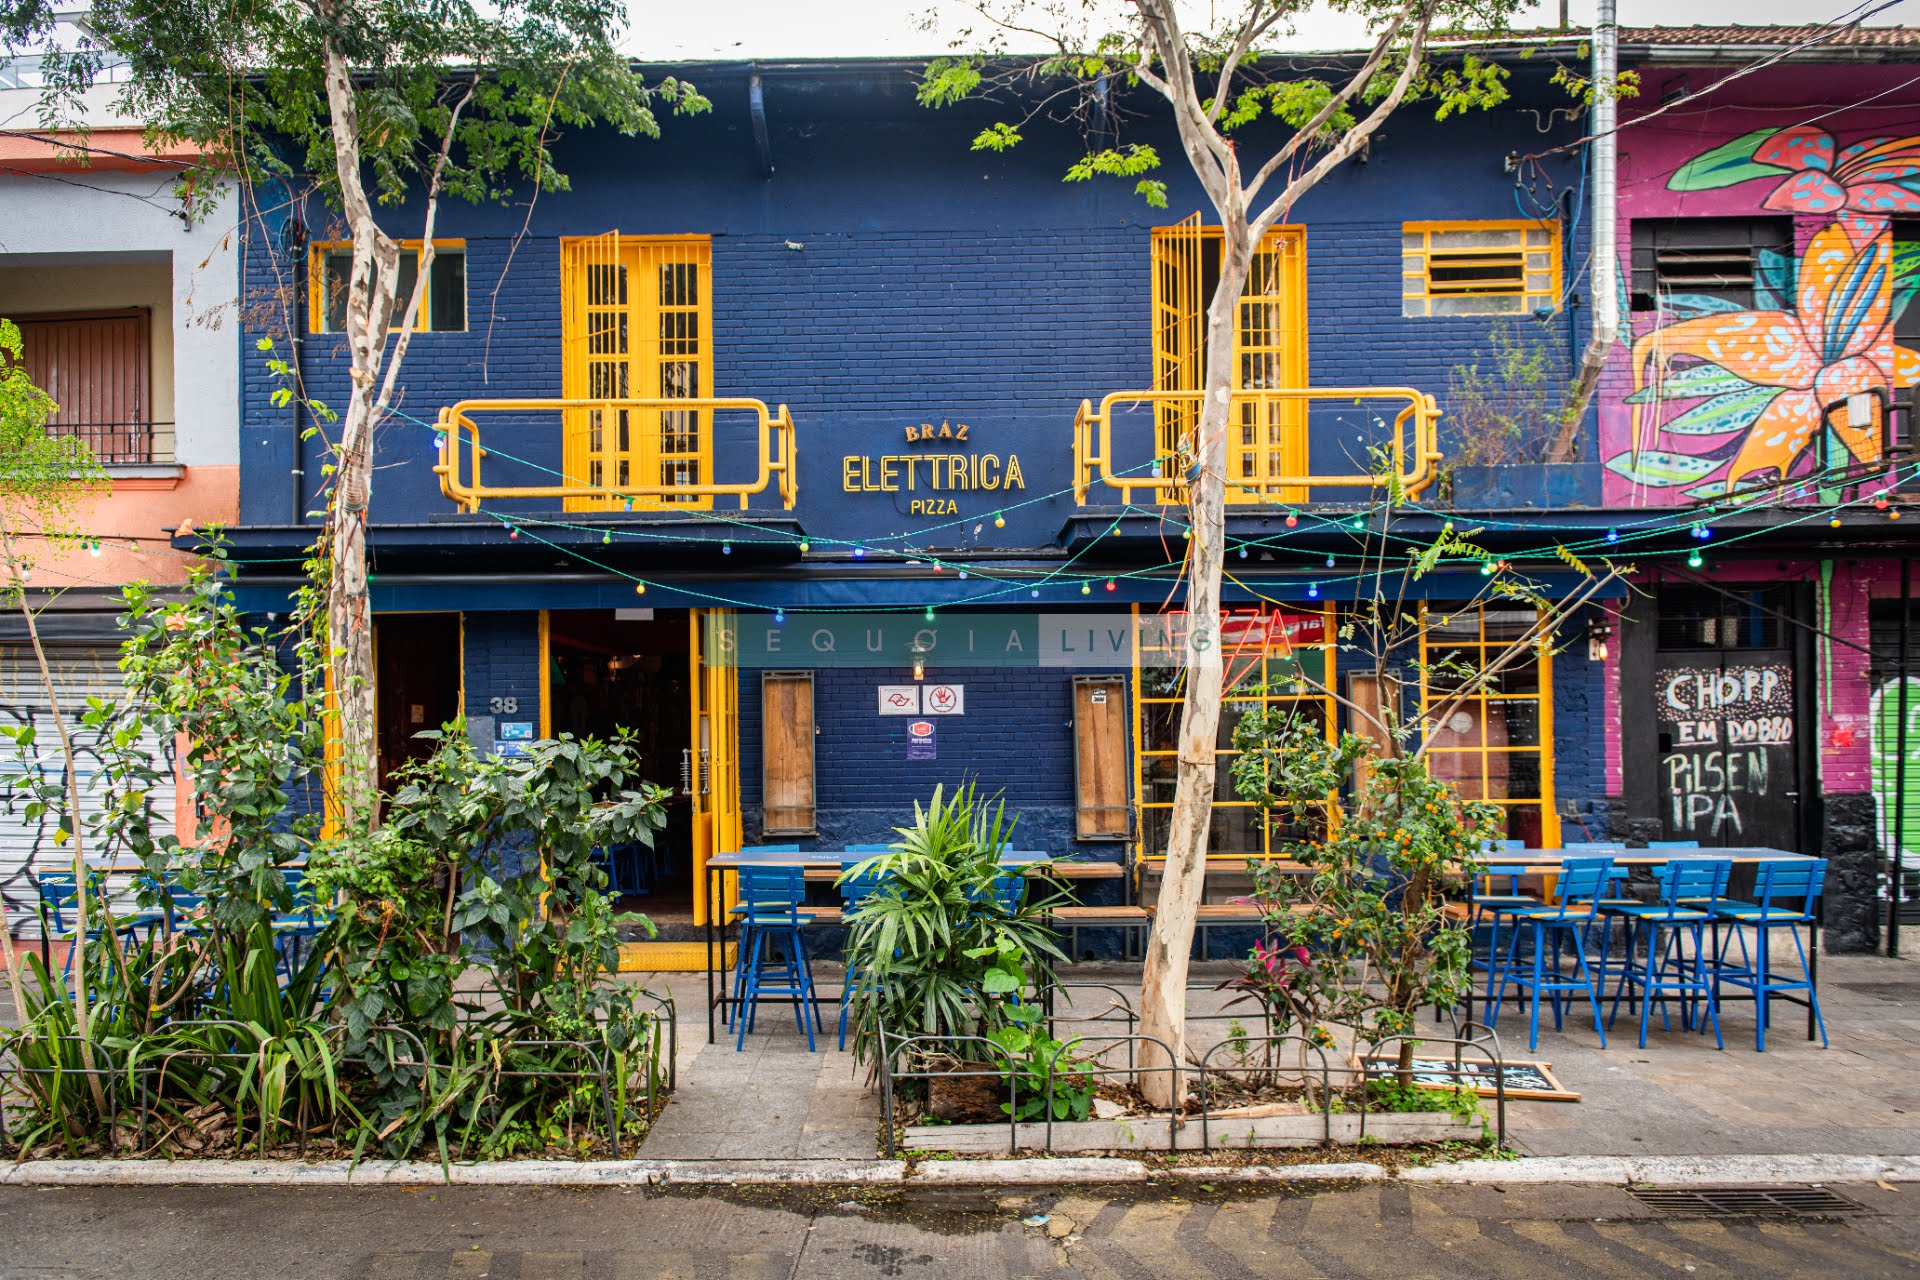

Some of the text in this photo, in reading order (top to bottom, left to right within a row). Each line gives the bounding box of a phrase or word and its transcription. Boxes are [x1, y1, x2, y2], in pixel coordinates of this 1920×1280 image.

[843, 454, 1024, 492] ELETTRICA
[910, 499, 958, 515] PIZZA
[1666, 670, 1779, 711] CHOPP
[489, 696, 518, 714] 38
[1677, 716, 1793, 744] EM DOBRO
